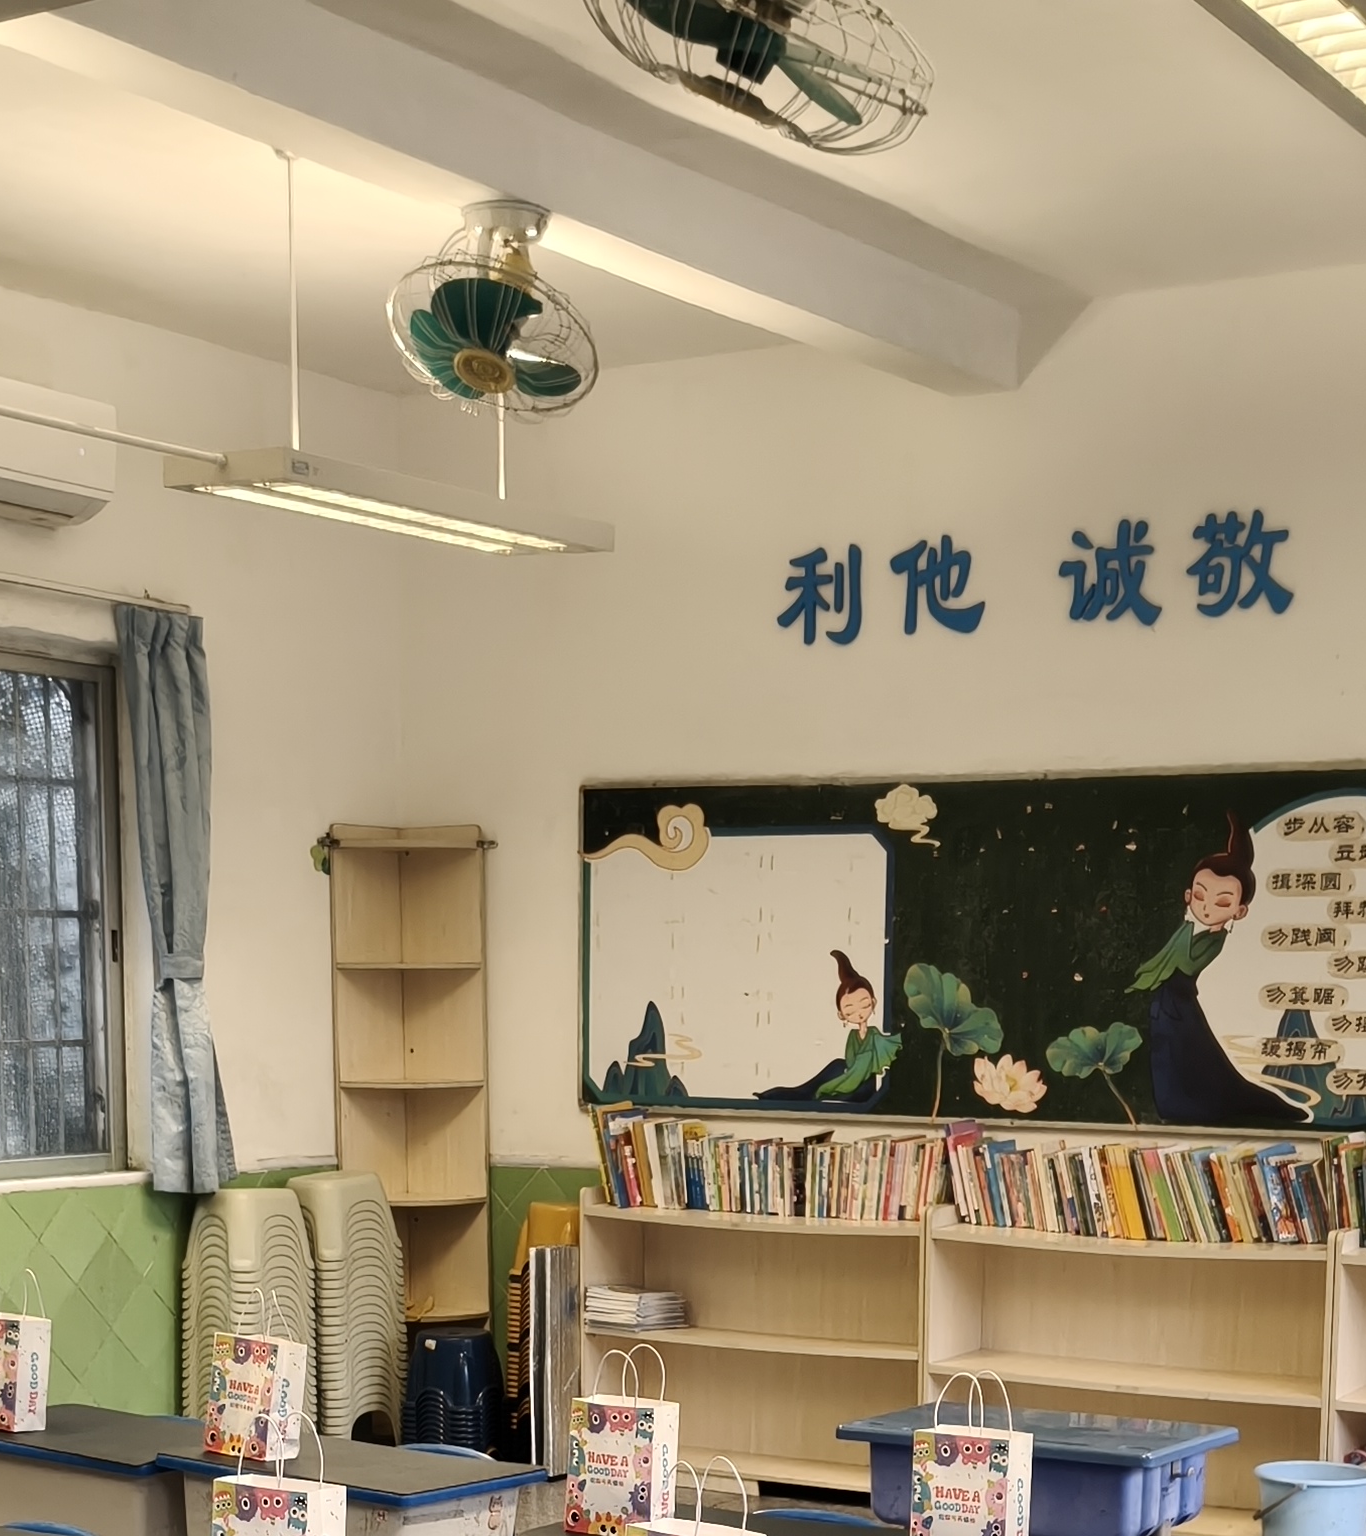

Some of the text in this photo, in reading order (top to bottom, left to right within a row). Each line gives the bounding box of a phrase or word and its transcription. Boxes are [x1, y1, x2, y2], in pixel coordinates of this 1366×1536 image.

[777, 533, 987, 646] 利他
[1058, 509, 1295, 627] 诚敬
[229, 1380, 254, 1394] HAVE
[588, 1452, 628, 1466] HAVE A
[935, 1486, 980, 1503] HAVE A
